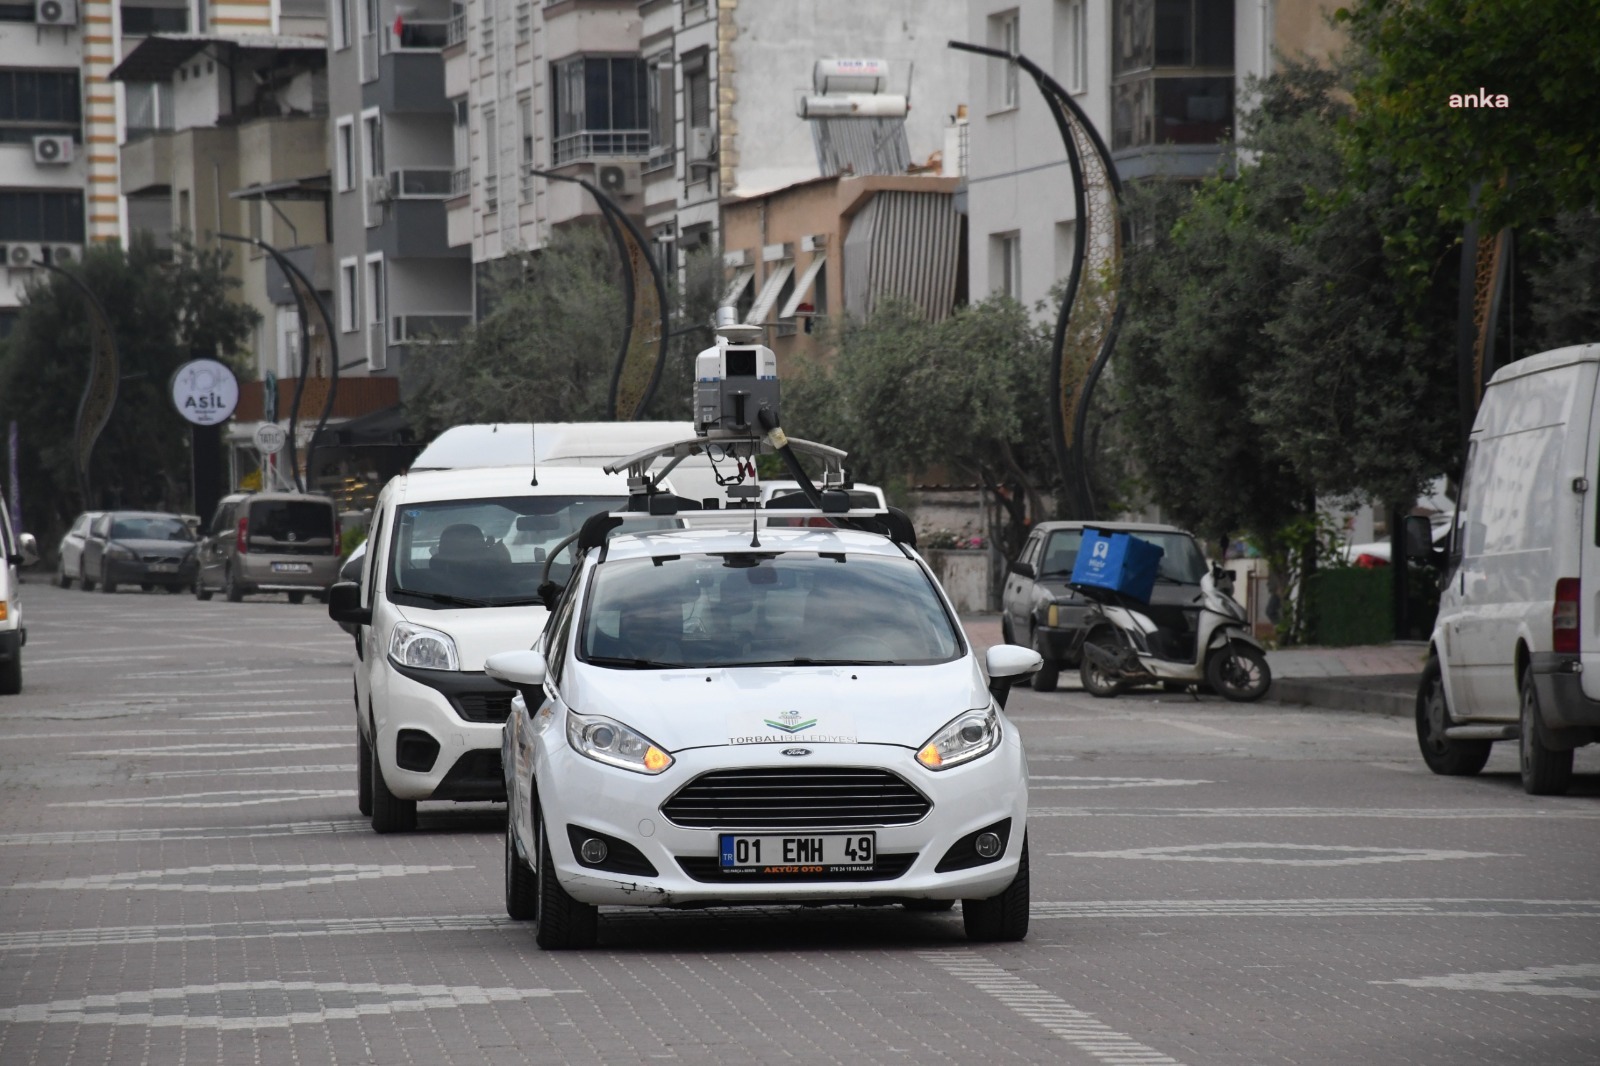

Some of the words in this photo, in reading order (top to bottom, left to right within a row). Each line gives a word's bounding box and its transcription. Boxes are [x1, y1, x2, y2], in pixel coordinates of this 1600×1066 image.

[185, 392, 227, 409] ASİL
[736, 838, 761, 863] 01
[782, 838, 823, 863] EMH
[844, 837, 871, 862] 49
[723, 853, 733, 861] TR
[764, 865, 799, 873] AKYÜZ
